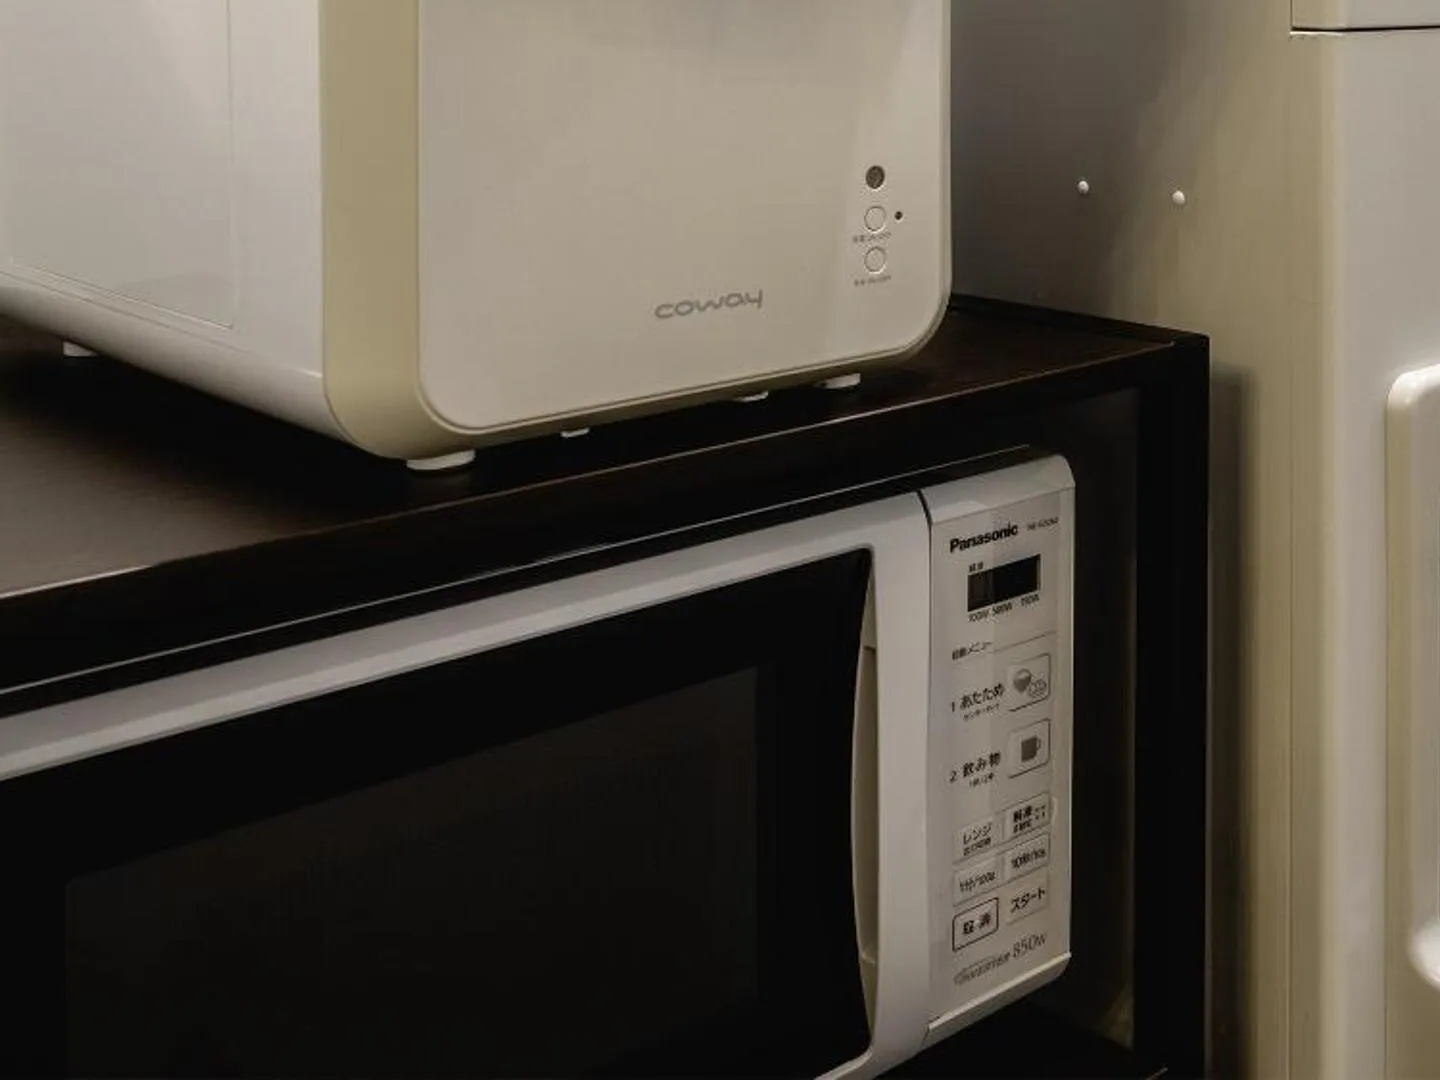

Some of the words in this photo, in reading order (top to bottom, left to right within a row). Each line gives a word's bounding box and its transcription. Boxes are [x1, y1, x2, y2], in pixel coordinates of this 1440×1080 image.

[654, 289, 763, 319] coway
[950, 521, 1019, 553] Panasonic
[963, 822, 993, 845] レンジ
[1010, 887, 1046, 914] スタート
